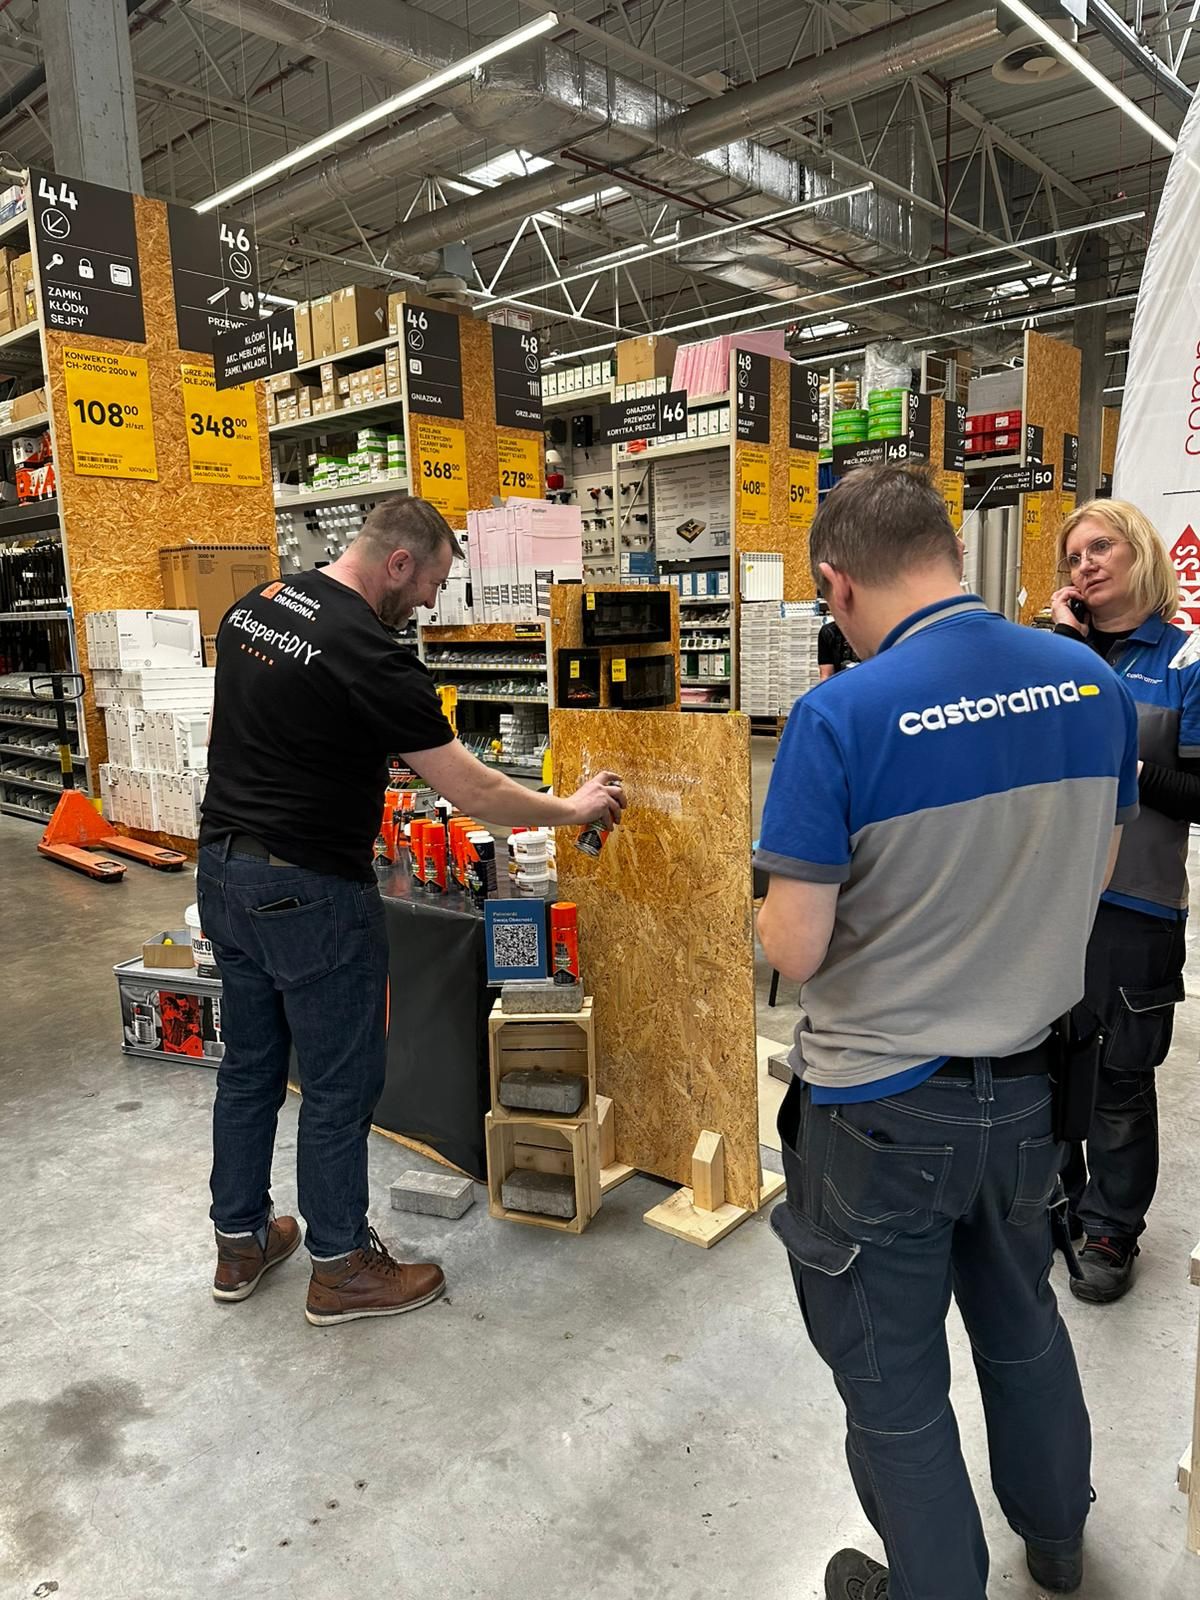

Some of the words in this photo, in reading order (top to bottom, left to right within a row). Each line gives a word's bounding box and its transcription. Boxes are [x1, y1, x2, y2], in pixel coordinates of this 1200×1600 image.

[38, 178, 79, 211] 44
[220, 223, 251, 252] 46
[47, 286, 82, 301] ZAMKI
[49, 299, 89, 316] KŁÓDKI
[50, 313, 85, 329] SEJFY
[407, 309, 428, 330] 46
[244, 330, 266, 346] KŁÓDKI
[272, 327, 294, 355] 44
[520, 334, 538, 354] 48
[65, 351, 119, 366] KONWEKTOR
[238, 343, 268, 360] MEBLOWE
[65, 361, 108, 373] CH-2010C
[108, 366, 129, 376] 2000
[130, 369, 138, 377] W
[738, 353, 752, 371] 48
[183, 368, 216, 379] GRZEJNI
[807, 371, 819, 387] 50
[184, 377, 216, 388] OLEJOW
[411, 392, 443, 405] GNIAZDKA
[909, 394, 919, 408] 50
[73, 399, 124, 428] 108
[124, 405, 139, 416] 00
[625, 404, 656, 416] GNIAZDKA
[662, 401, 685, 423] 46
[957, 405, 966, 419] 52
[190, 413, 235, 438] 348
[235, 418, 248, 428] 00
[623, 413, 657, 425] PRZEWODY
[634, 422, 657, 432] PESZLE
[1027, 426, 1035, 439] 52
[888, 443, 907, 459] 48
[423, 460, 452, 480] 368
[1035, 471, 1052, 484] 50
[502, 470, 526, 488] 278
[742, 480, 761, 495] 408
[790, 484, 804, 503] 59
[227, 608, 322, 665] #EkspertDIY
[898, 680, 1081, 736] castorama
